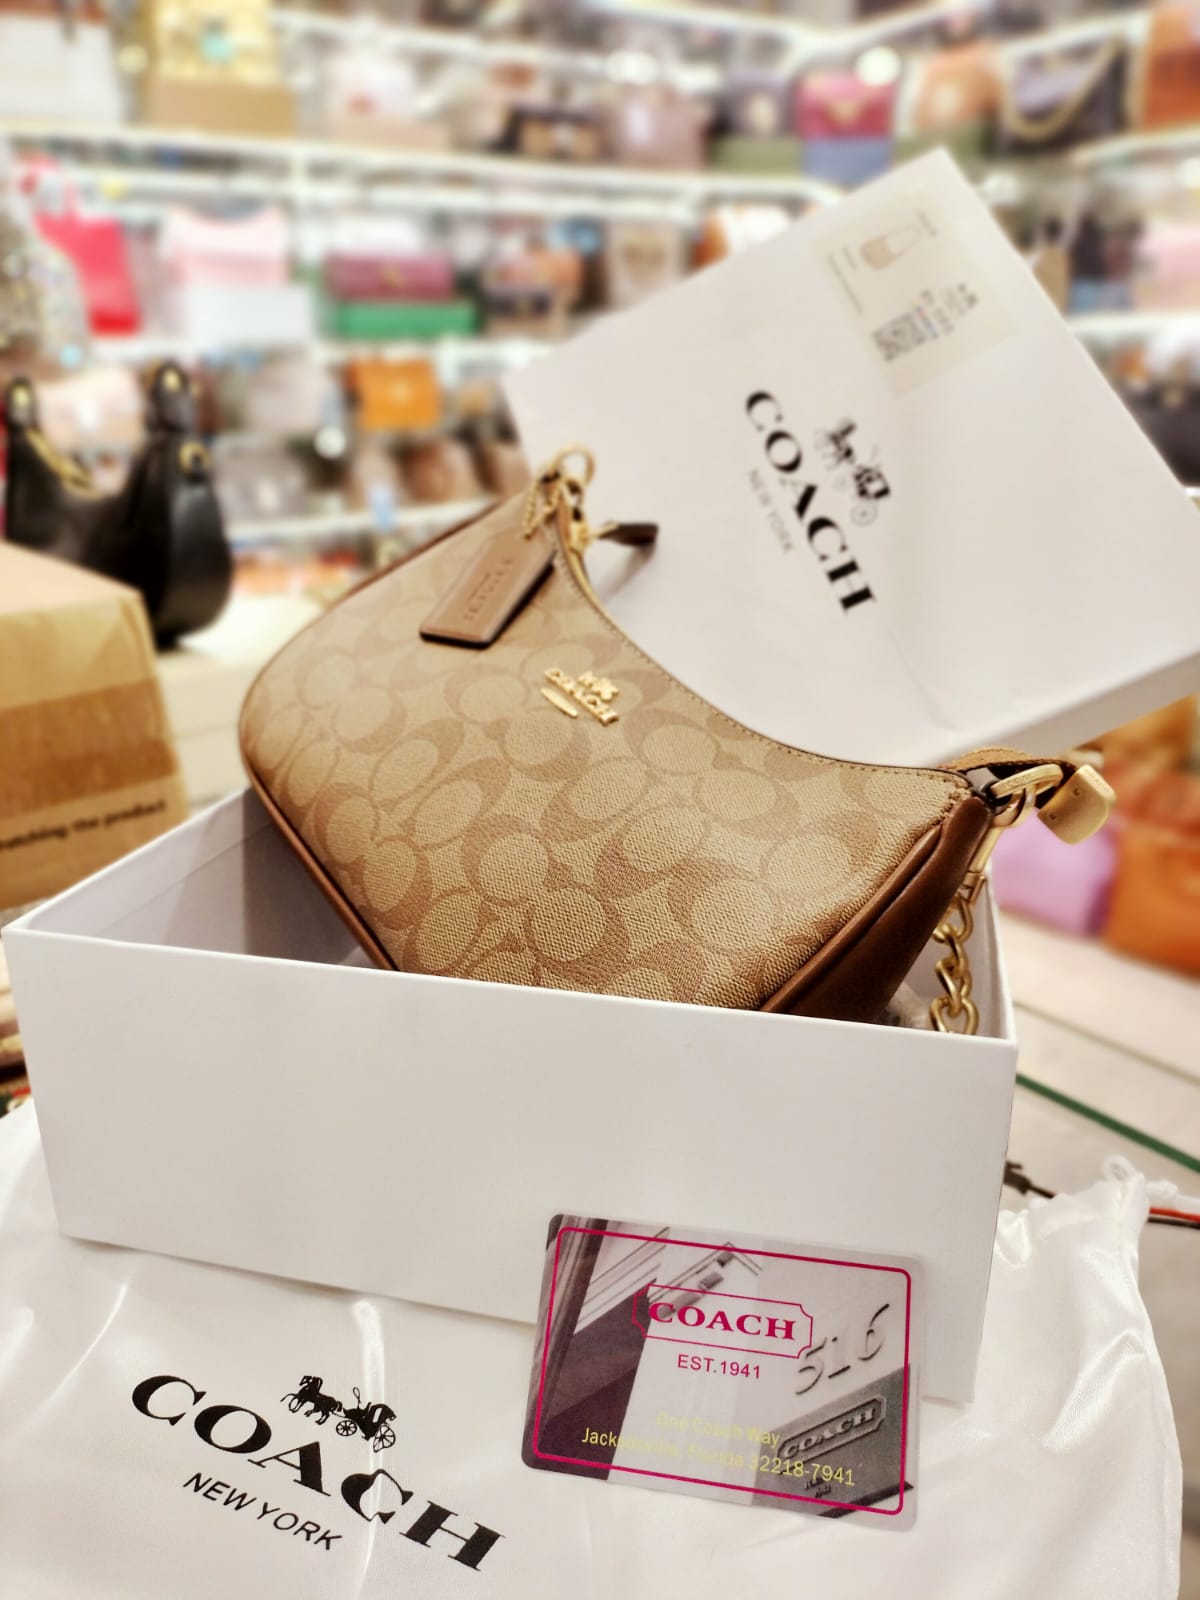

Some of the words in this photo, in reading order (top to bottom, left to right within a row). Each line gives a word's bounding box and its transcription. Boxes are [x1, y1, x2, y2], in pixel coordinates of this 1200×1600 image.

[746, 390, 876, 614] COACH
[648, 1302, 797, 1341] COACH
[677, 1354, 761, 1379] EST.1941
[795, 1303, 890, 1395] 516
[747, 1426, 779, 1448] Way
[785, 1406, 877, 1460] COACH
[132, 1375, 506, 1571] COACH
[749, 1453, 856, 1487] 32218-7941
[183, 1472, 257, 1512] NEW
[257, 1502, 343, 1551] YORK
